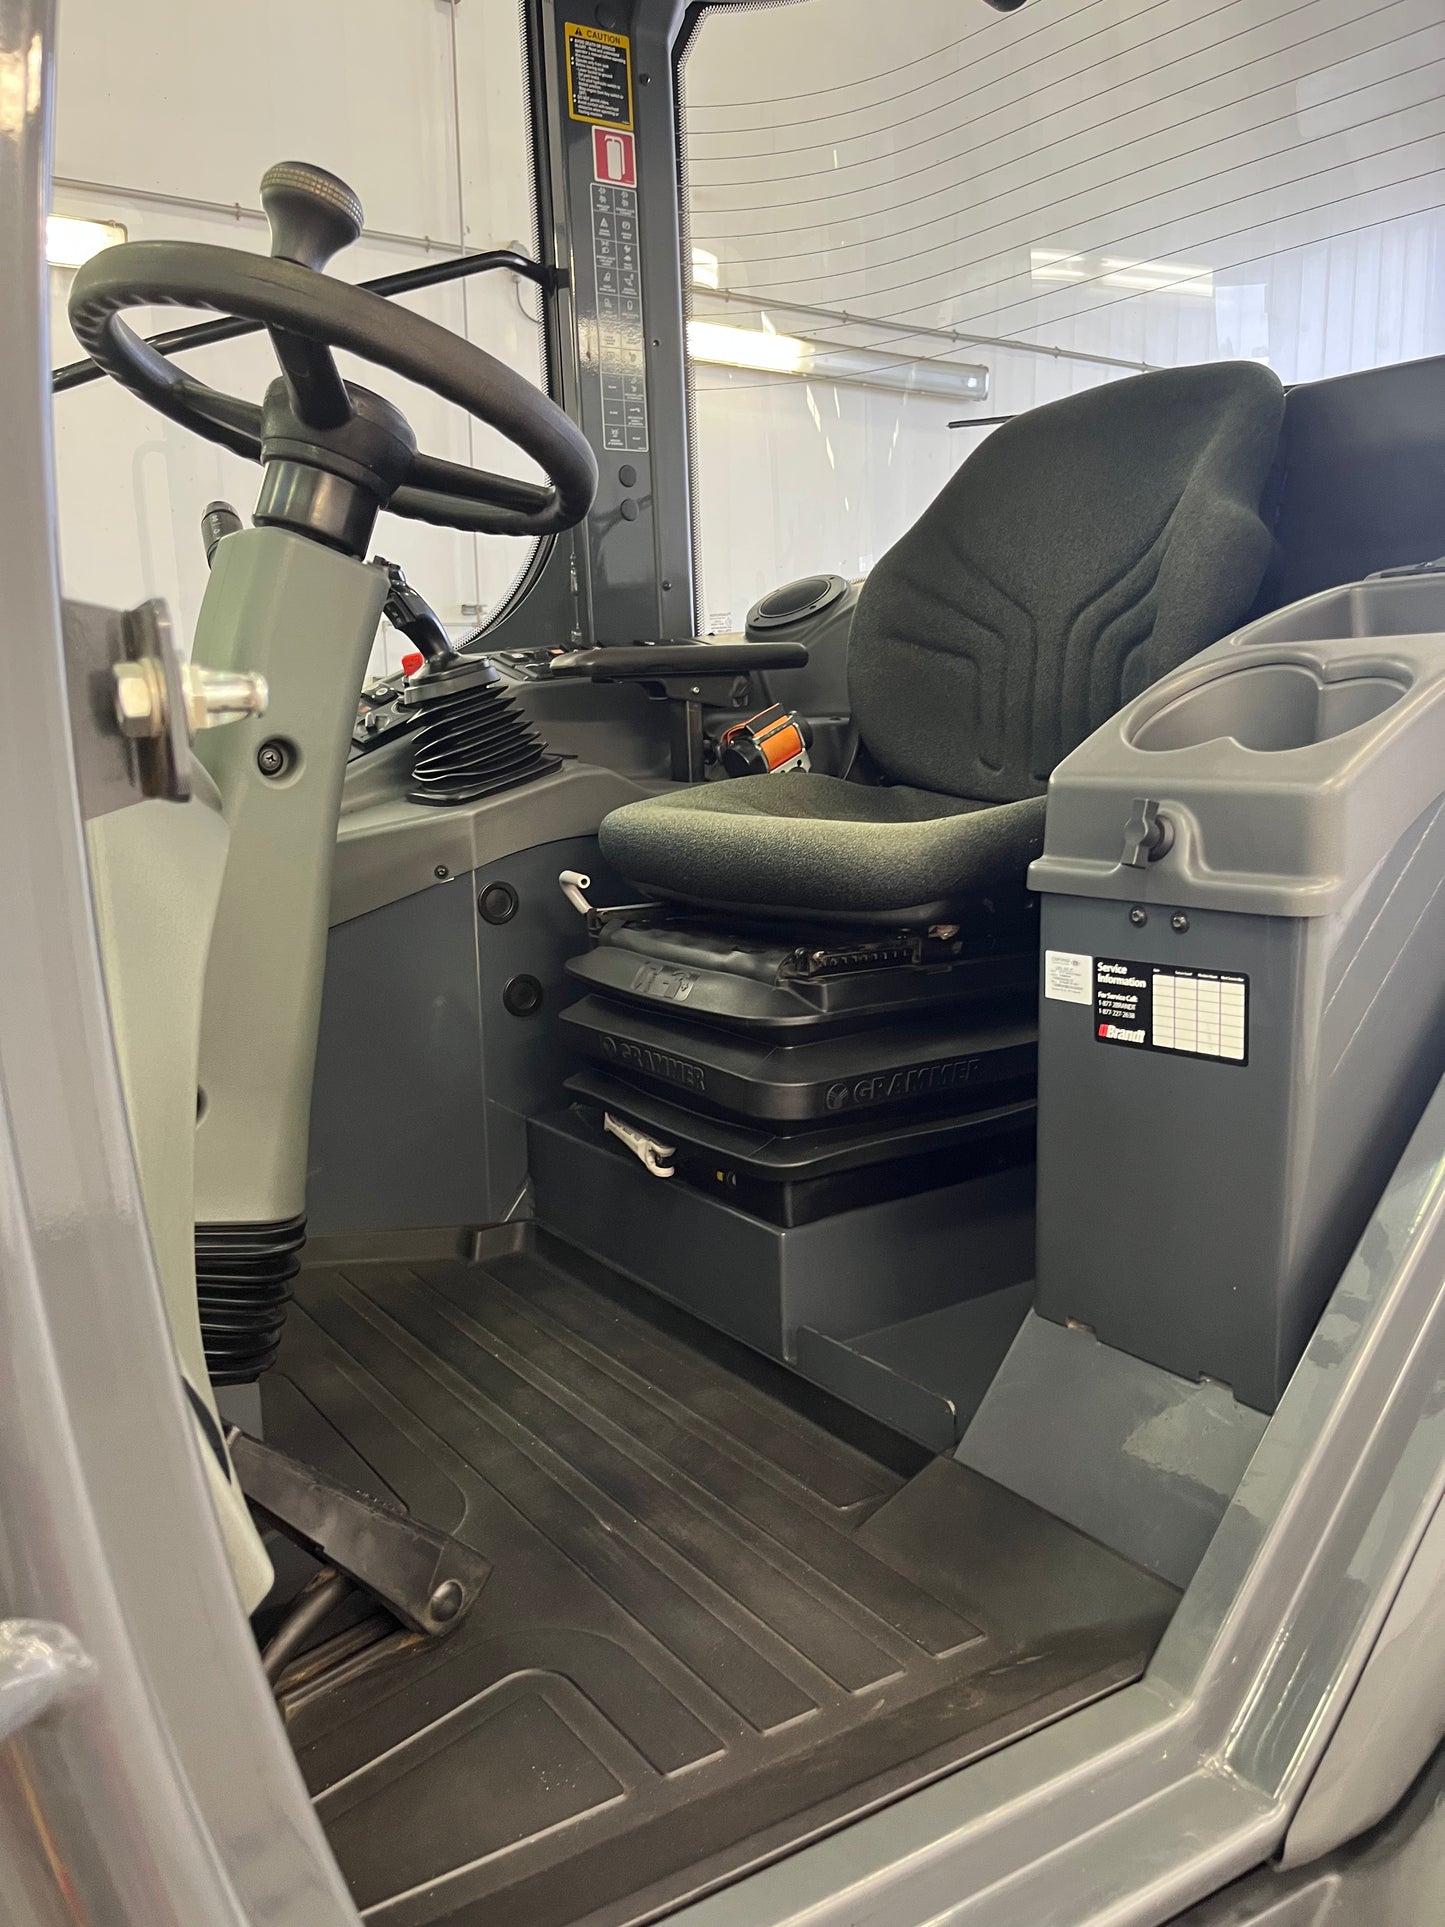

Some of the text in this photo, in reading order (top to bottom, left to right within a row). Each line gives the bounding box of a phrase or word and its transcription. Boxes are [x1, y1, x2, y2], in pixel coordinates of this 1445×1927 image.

[586, 30, 621, 45] CAUTION
[1097, 961, 1128, 975] Service
[1097, 973, 1147, 989] Information
[1107, 992, 1126, 1001] Service
[1106, 1024, 1146, 1043] Brandt
[618, 1042, 705, 1091] GRAMMER
[853, 1058, 981, 1104] GRAMMER
